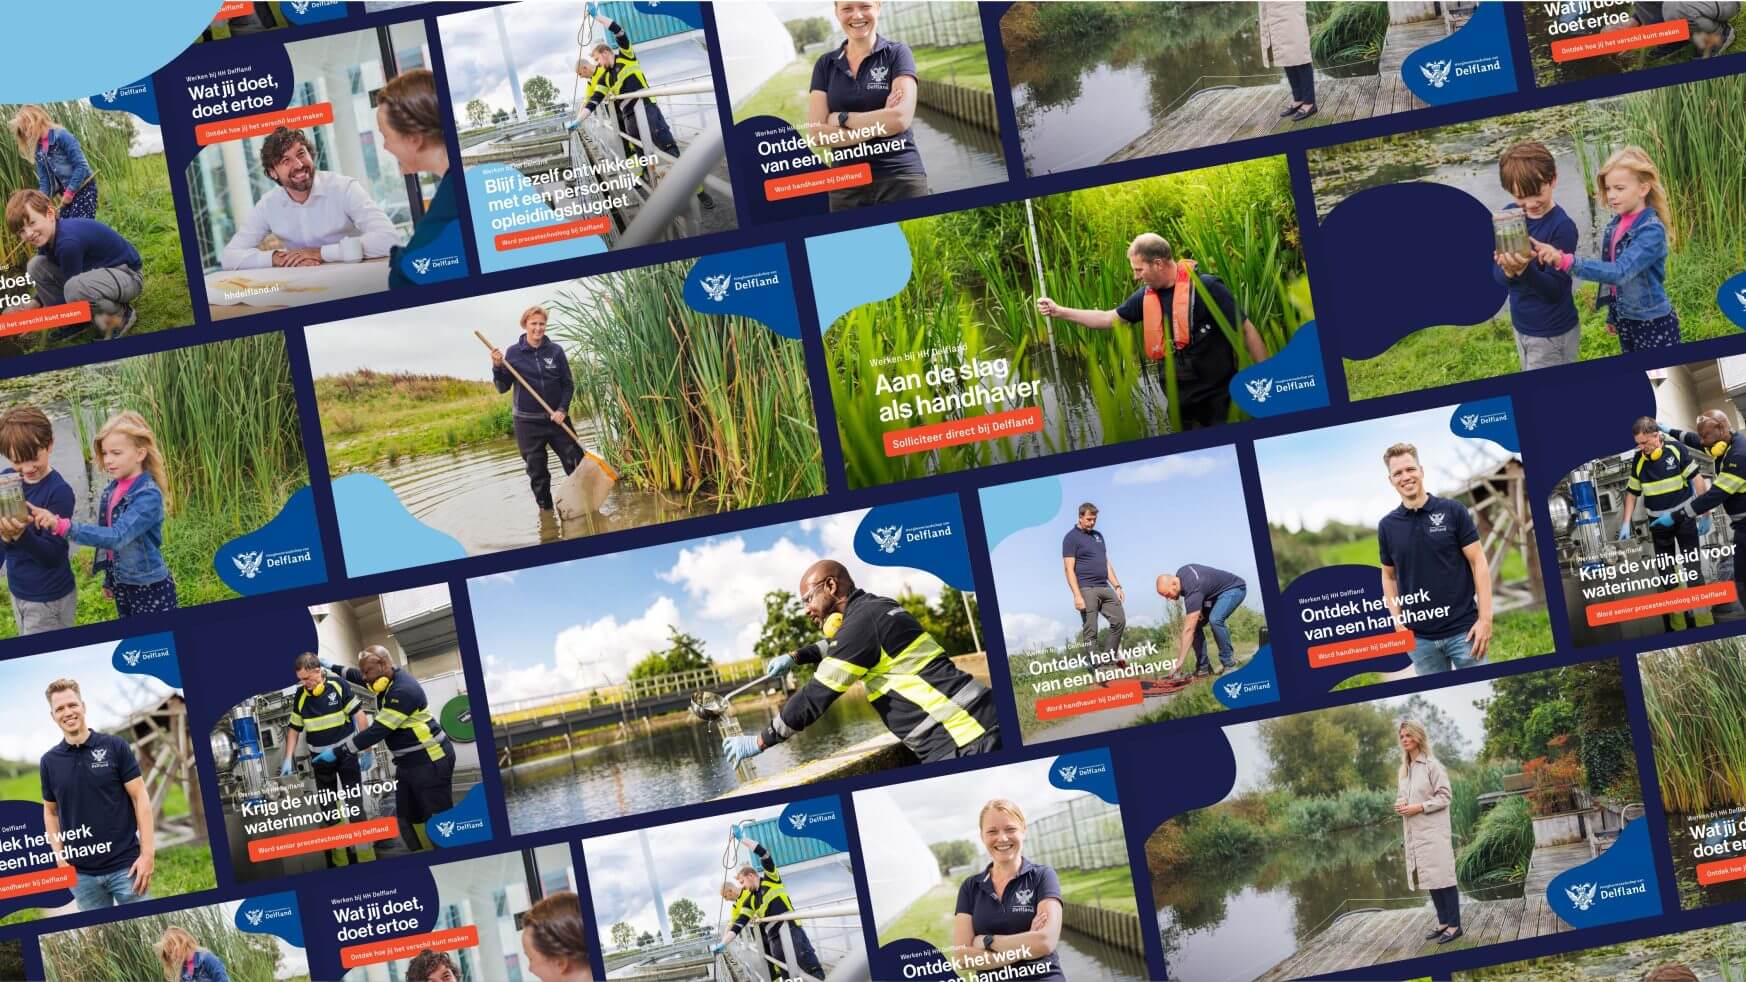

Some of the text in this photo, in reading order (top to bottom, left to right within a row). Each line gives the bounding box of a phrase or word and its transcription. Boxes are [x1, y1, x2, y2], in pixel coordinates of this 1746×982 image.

[1544, 1, 1577, 17] Wat
[1548, 12, 1629, 34] doet ertoe
[1455, 60, 1500, 76] Delfland
[188, 74, 278, 100] Wat jij doet,
[192, 95, 273, 118] doet ertoe
[758, 121, 886, 155] Ontdek het werk
[761, 139, 906, 173] van een handhaver
[484, 175, 514, 193] Blijf
[517, 167, 559, 190] jezelf
[563, 153, 658, 180] ontwikkelen
[488, 173, 641, 211] met een persoonlijk
[492, 195, 629, 231] opleidingsbugdet
[432, 258, 459, 267] Delfland
[734, 274, 779, 290] Delfland
[869, 342, 968, 367] Werken bij HH Delfland
[876, 357, 1008, 395] Aan de slag
[1275, 377, 1315, 392] Delfland
[880, 381, 1039, 422] als handhaver
[1480, 414, 1507, 424] Delfland
[893, 415, 1034, 449] Solliciteer direct bij Delfland
[906, 525, 951, 542] Delfland
[266, 551, 311, 567] Delfland
[1579, 563, 1616, 580] Krijg
[1619, 559, 1639, 574] de
[1641, 547, 1698, 568] vrijheid
[1701, 543, 1736, 559] voor
[1582, 568, 1698, 598] waterinnovatie
[1298, 596, 1321, 604] Werken
[1340, 587, 1364, 597] Delfland
[1301, 588, 1430, 622] Ontdek het werk
[1304, 606, 1449, 640] van een handhaver
[142, 650, 169, 659] Delfland
[1029, 641, 1157, 674] Ontdek het werk
[1032, 659, 1177, 692] van een handhaver
[1243, 682, 1270, 692] Delfland
[1079, 766, 1105, 775] Delfland
[241, 799, 278, 816] Krijg
[281, 795, 301, 809] de
[304, 782, 360, 803] vrijheid
[363, 779, 398, 795] voor
[244, 804, 360, 834] waterinnovatie
[456, 821, 483, 831] Delfland
[808, 813, 835, 823] Delfland
[1689, 819, 1736, 839] Wat jij
[23, 824, 92, 847] het werk
[28, 842, 111, 865] handhaver
[1693, 841, 1730, 857] doet
[372, 887, 396, 897] Delfland
[1600, 883, 1646, 899] Delfland
[265, 909, 292, 919] Delfland
[333, 897, 423, 923] Wat jij doet,
[337, 918, 418, 941] doet ertoe
[903, 944, 1032, 978] Ontdek het werk
